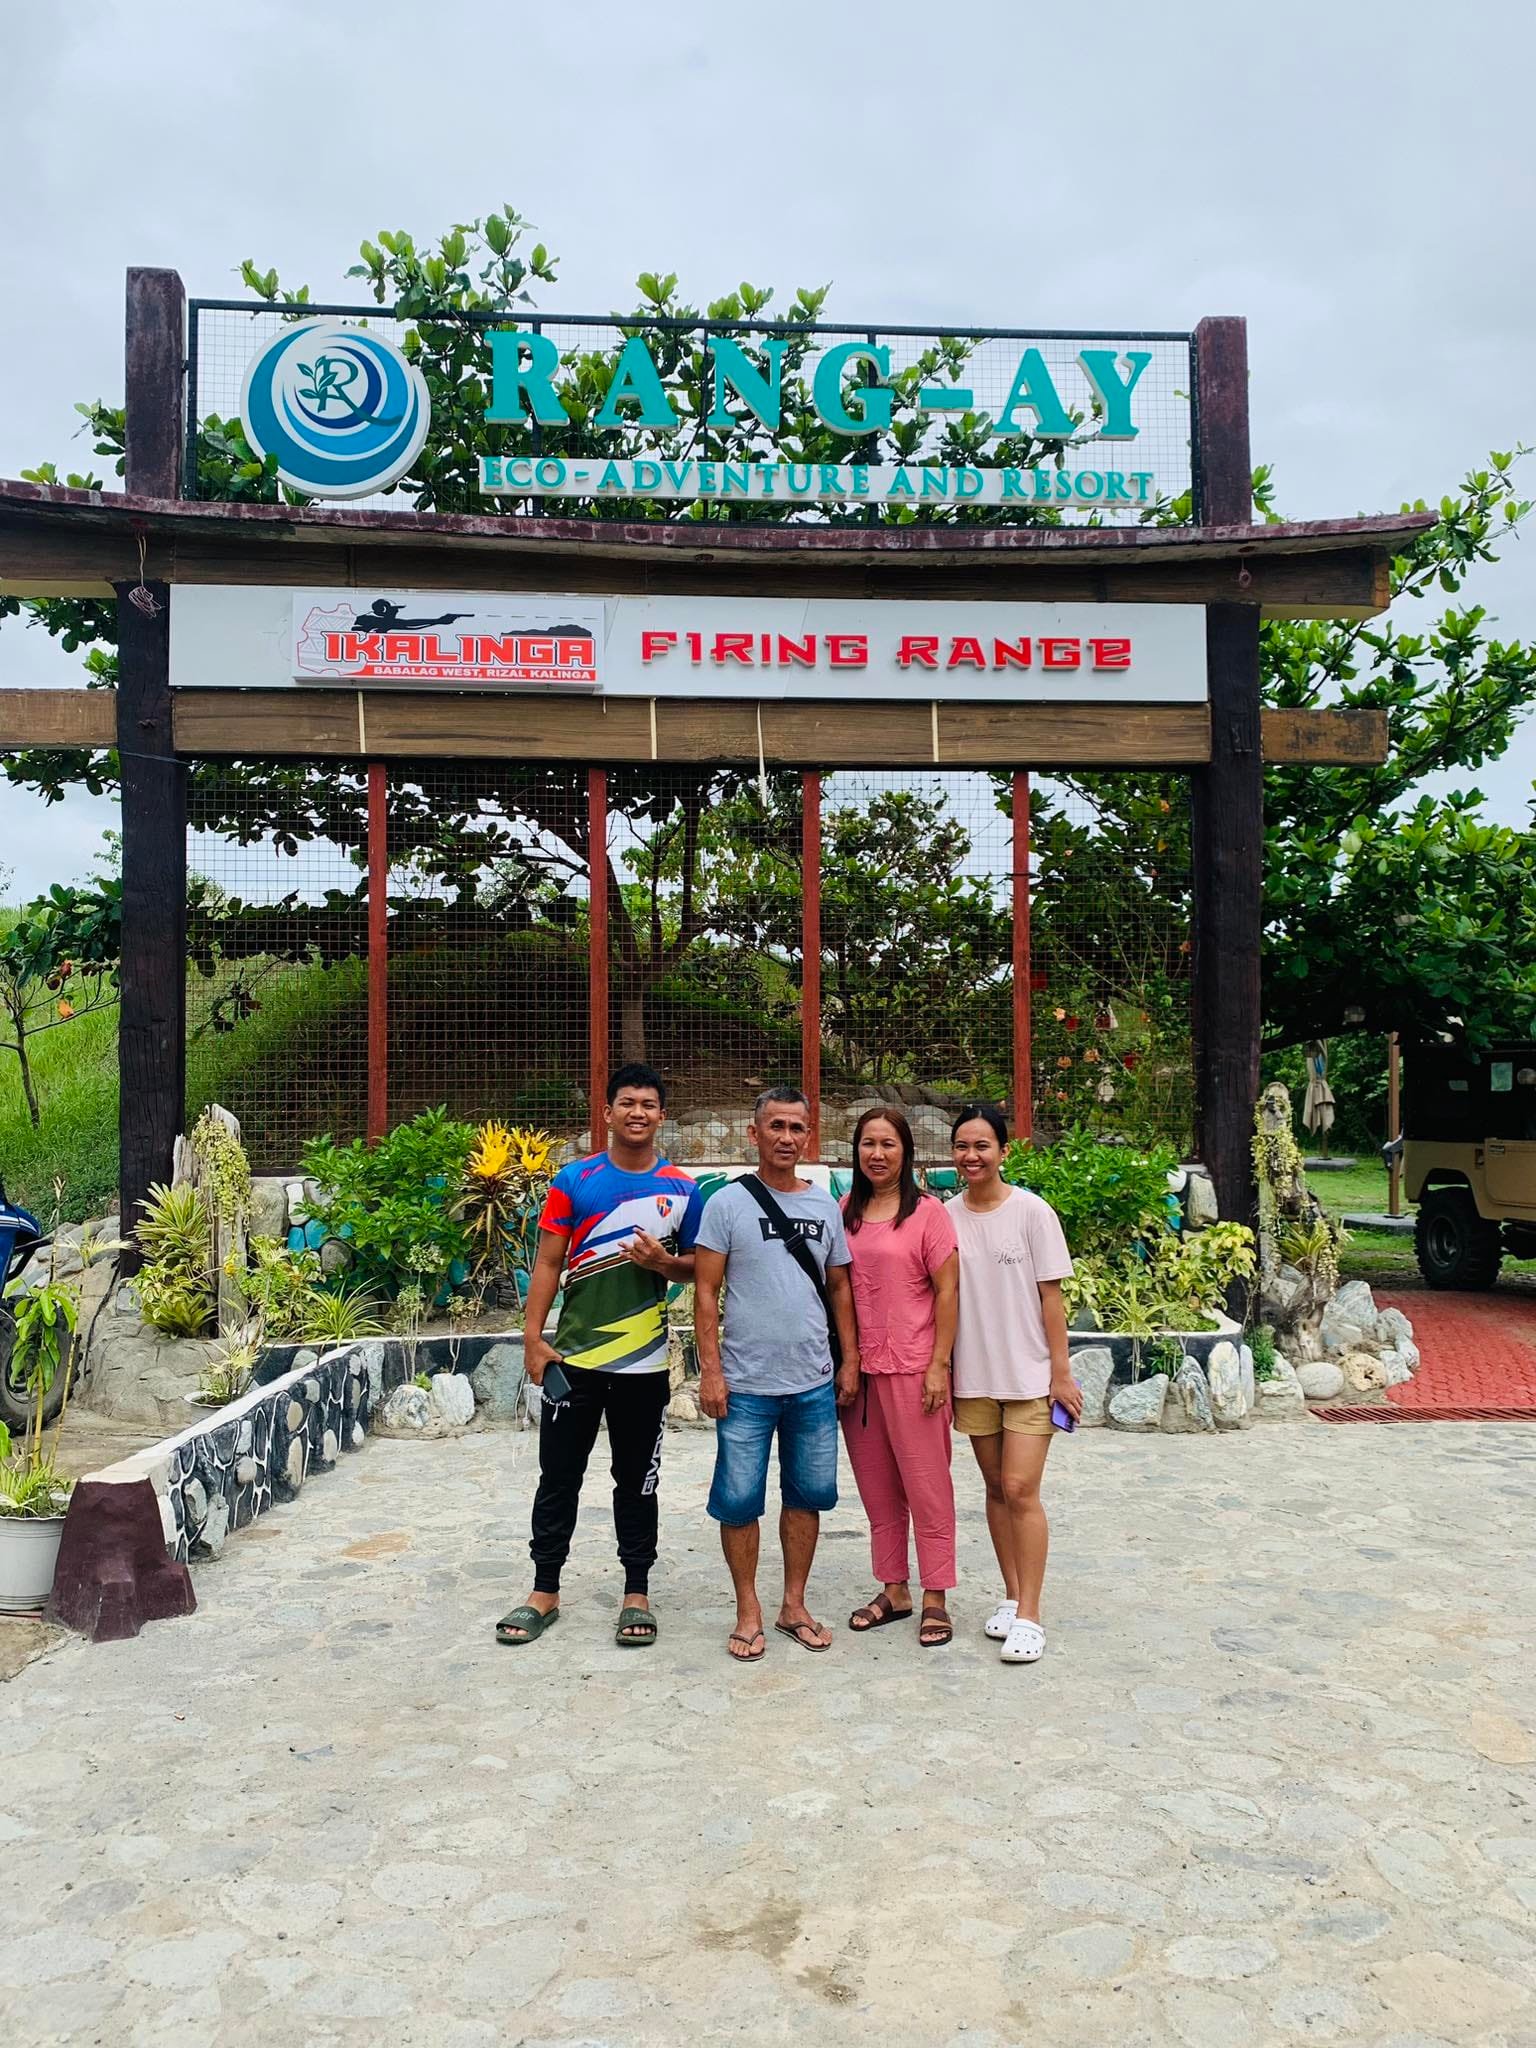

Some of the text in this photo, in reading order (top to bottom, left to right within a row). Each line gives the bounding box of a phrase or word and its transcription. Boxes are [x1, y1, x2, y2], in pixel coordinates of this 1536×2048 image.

[483, 330, 1153, 441] RANG-AY
[483, 455, 1154, 502] ECO-ADVENTURE AND RESORT
[321, 630, 596, 668] IKALINGA
[641, 631, 1132, 672] FIRING RANGE
[373, 666, 591, 680] BABALAG WEST, RIZAL KALINGA
[767, 1221, 819, 1237] LI'S
